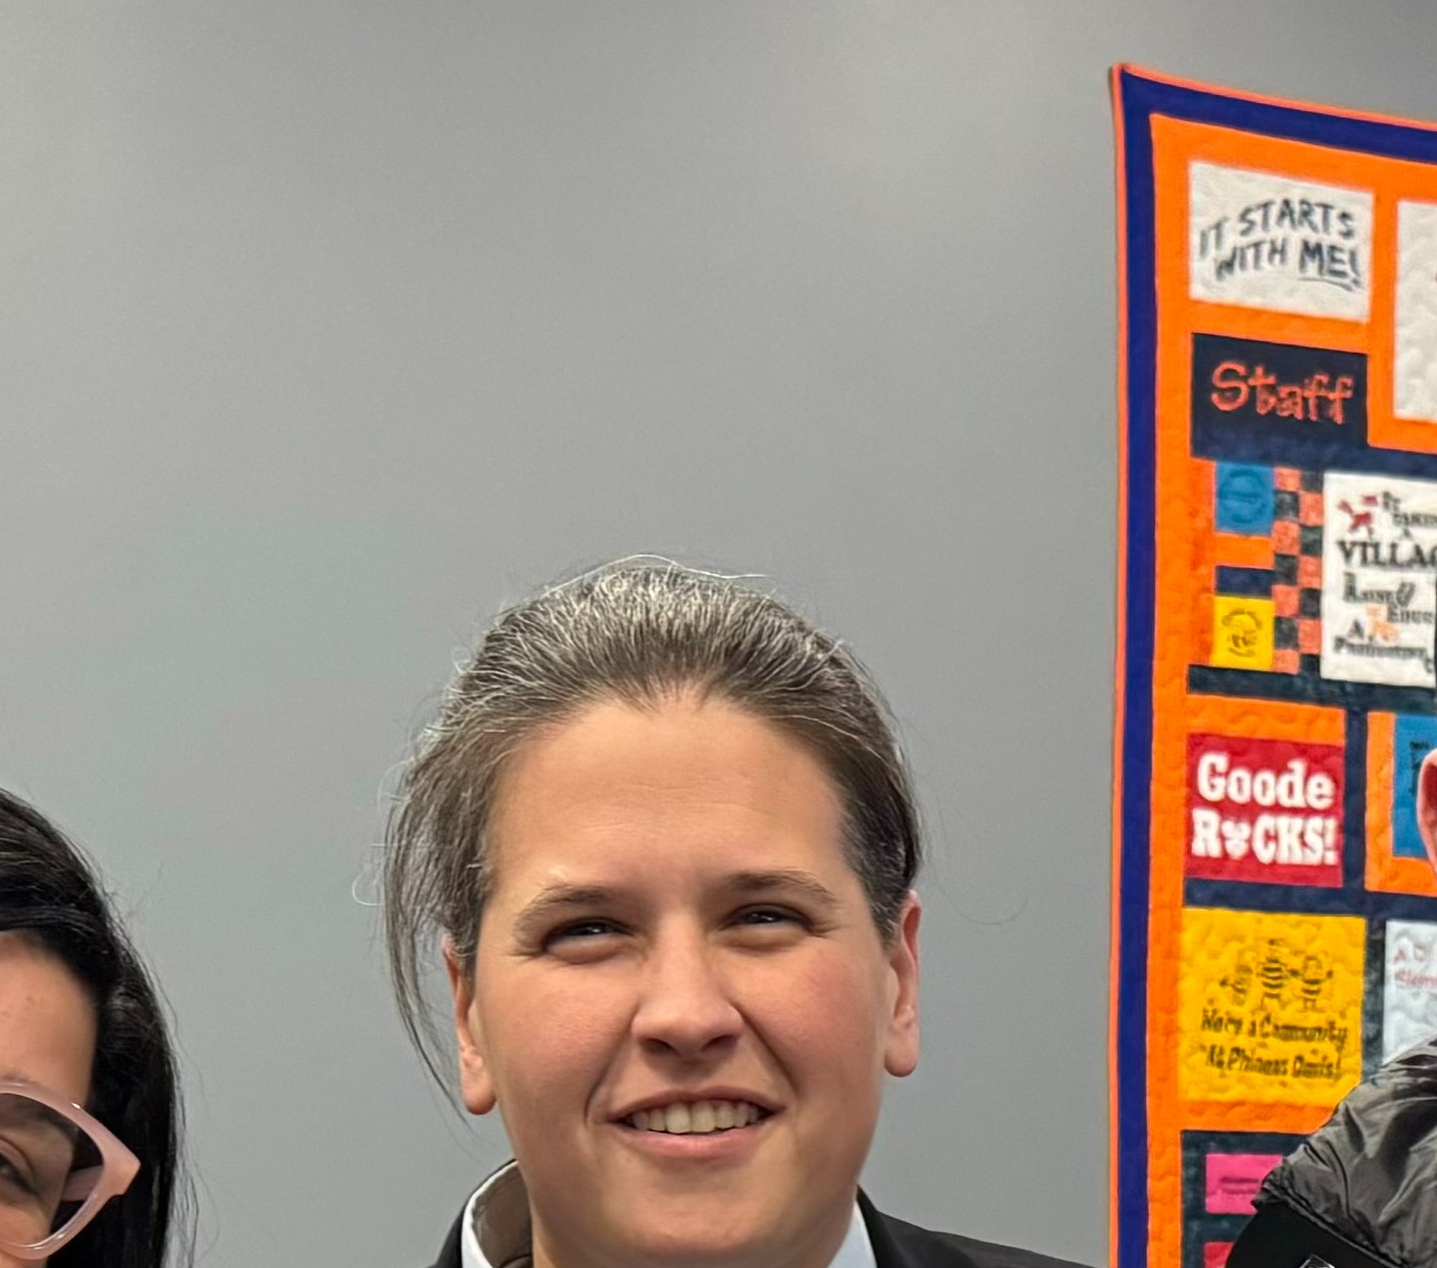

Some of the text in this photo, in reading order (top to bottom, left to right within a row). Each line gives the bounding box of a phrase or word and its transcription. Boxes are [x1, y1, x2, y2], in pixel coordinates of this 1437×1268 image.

[1199, 199, 1355, 259] IT STARTS
[1215, 237, 1361, 289] WITH ME!
[1211, 360, 1354, 425] Staff
[1197, 751, 1336, 810] Goode
